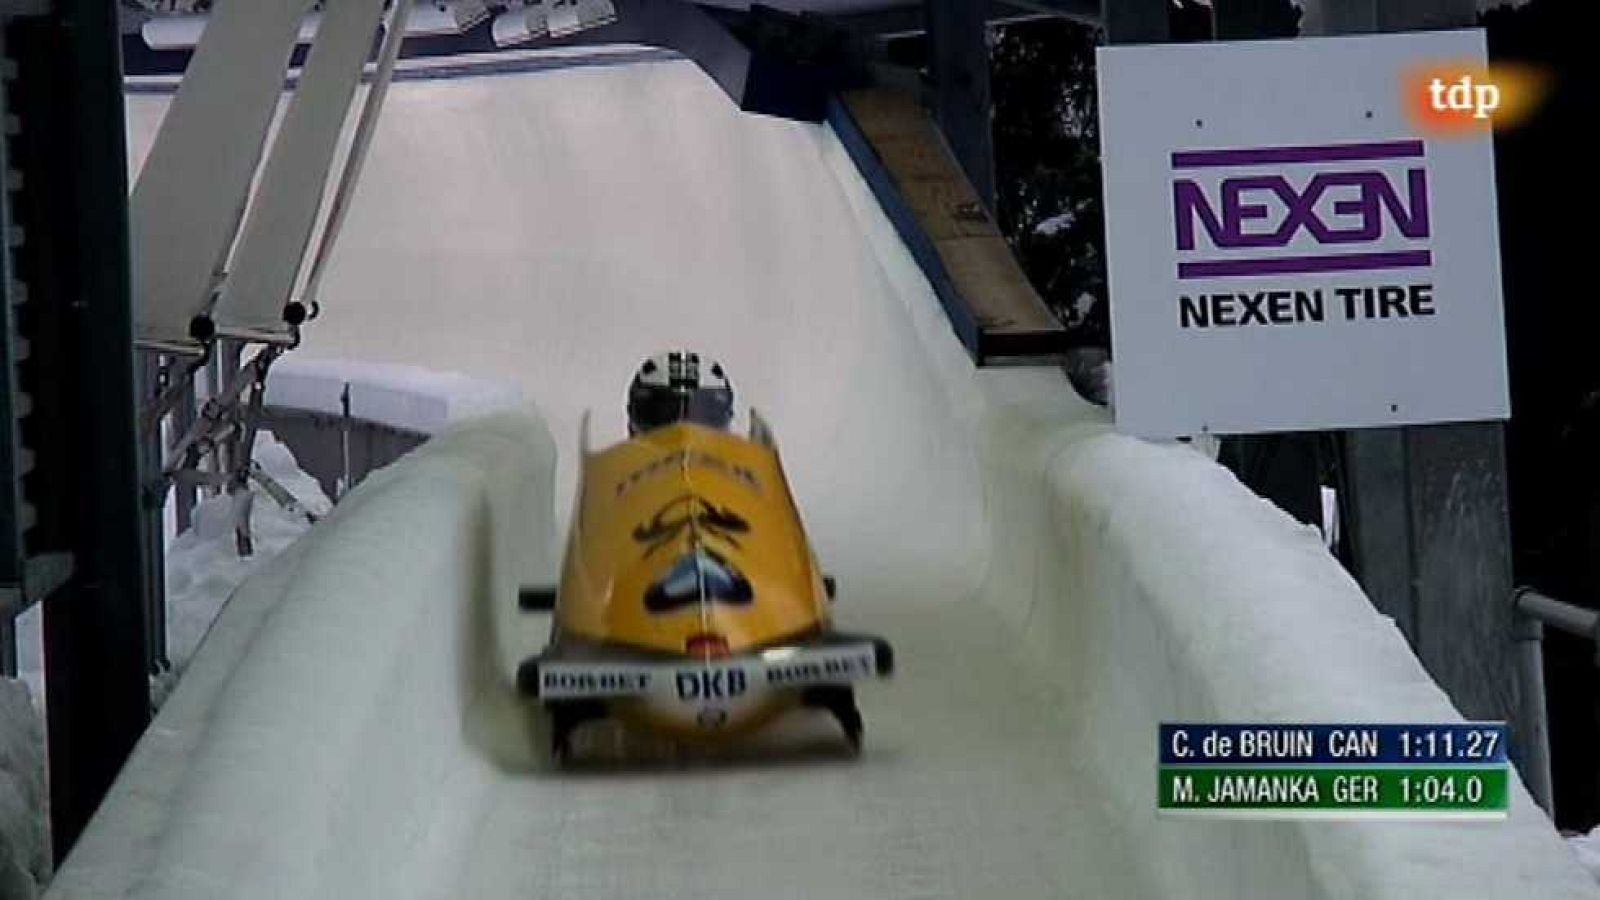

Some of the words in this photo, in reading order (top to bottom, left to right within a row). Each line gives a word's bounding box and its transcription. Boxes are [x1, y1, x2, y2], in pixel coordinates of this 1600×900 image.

[1173, 168, 1430, 250] NEXEN
[1179, 289, 1324, 327] NEXEN
[1335, 284, 1435, 319] TIRE
[676, 668, 747, 699] DKB
